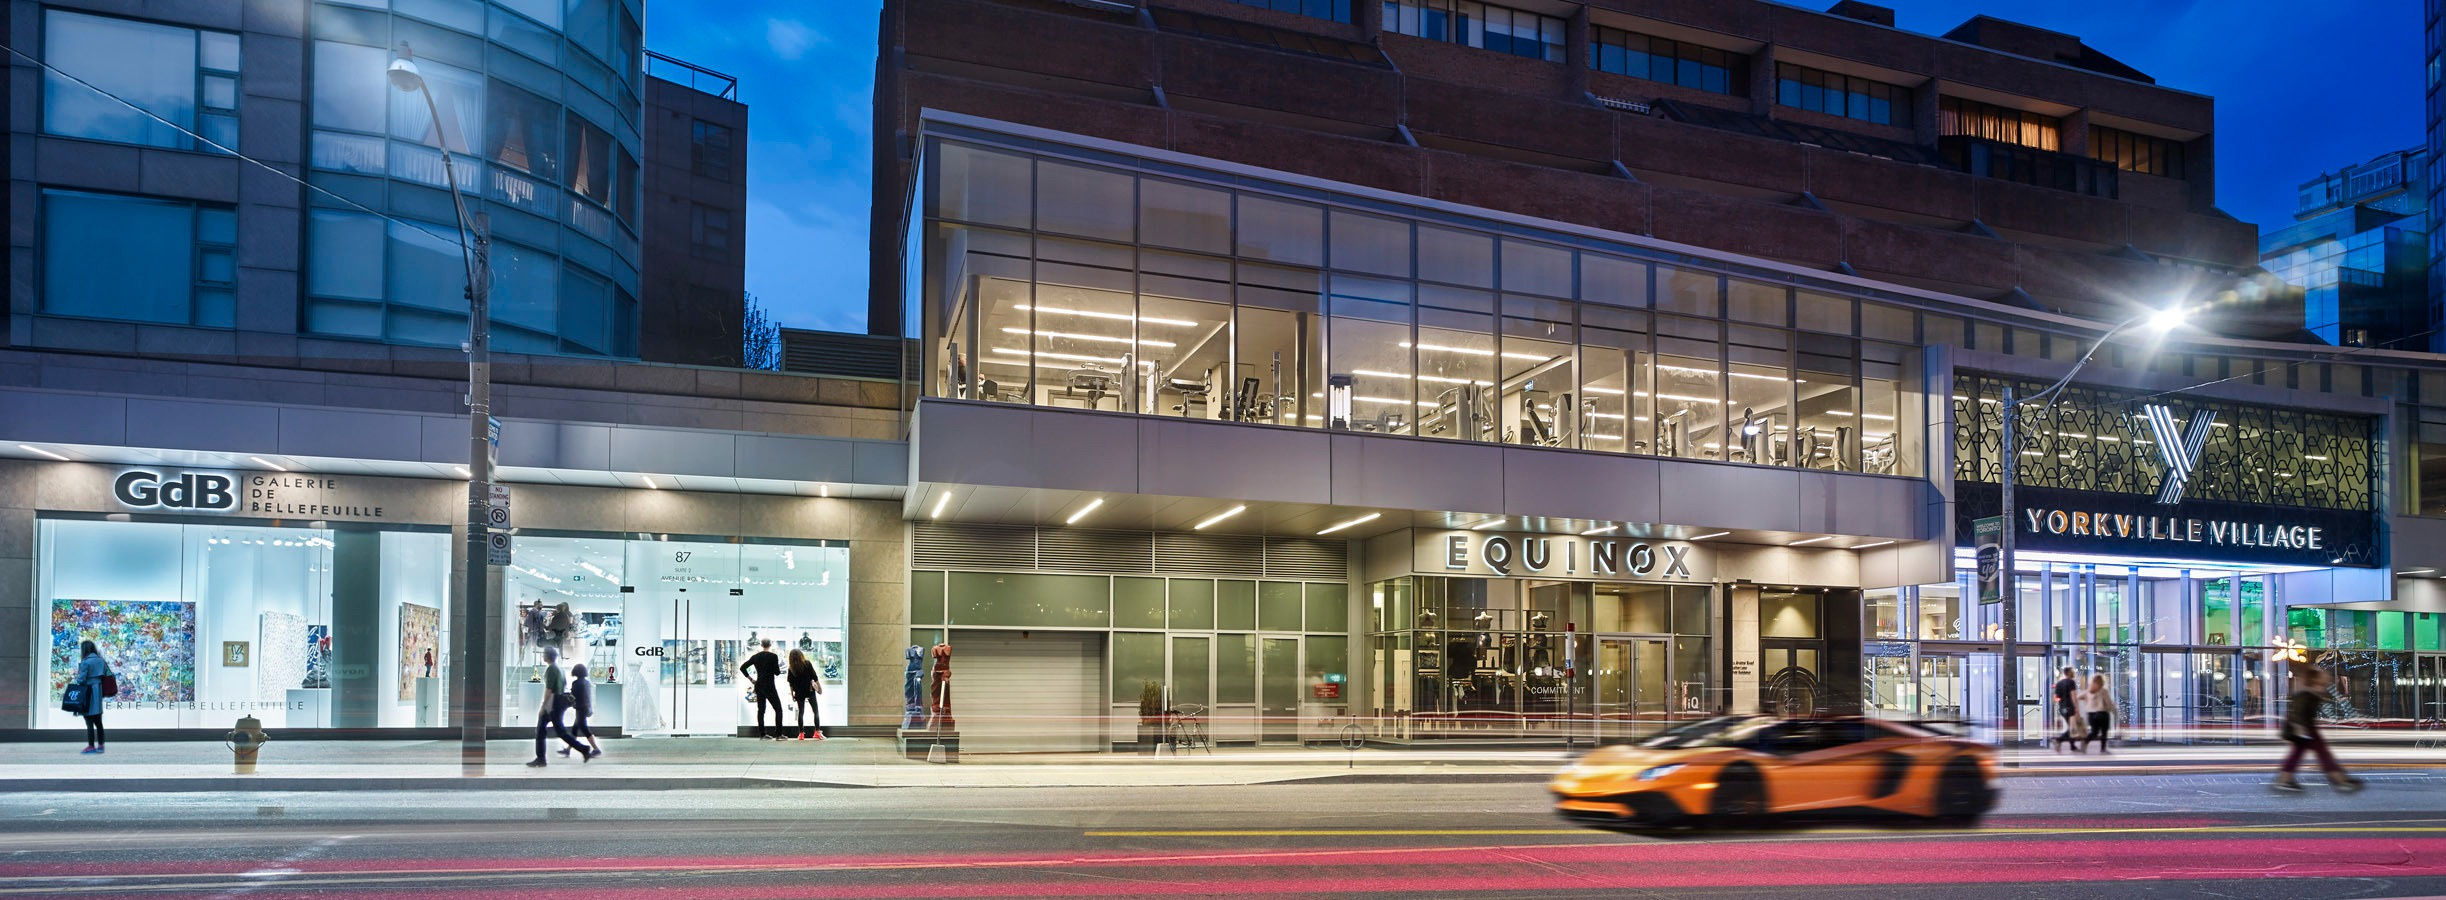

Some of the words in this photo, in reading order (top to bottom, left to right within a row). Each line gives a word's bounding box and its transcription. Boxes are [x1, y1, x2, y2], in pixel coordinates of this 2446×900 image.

[252, 476, 336, 490] GALERIE
[114, 471, 234, 509] GdB
[252, 489, 274, 499] DE
[252, 502, 383, 517] BELLEFEUILLE
[1976, 525, 2001, 534] TORONTO
[2026, 508, 2202, 543] YORKVILLE
[2210, 520, 2323, 550] VILLAGE
[675, 551, 691, 563] 87
[1446, 535, 1691, 577] EQUINOX
[635, 646, 664, 657] GdB
[105, 701, 142, 711] ERIE
[156, 701, 176, 711] DE
[190, 701, 304, 711] BELLEFEUILLE
[1687, 696, 1699, 709] iQ
